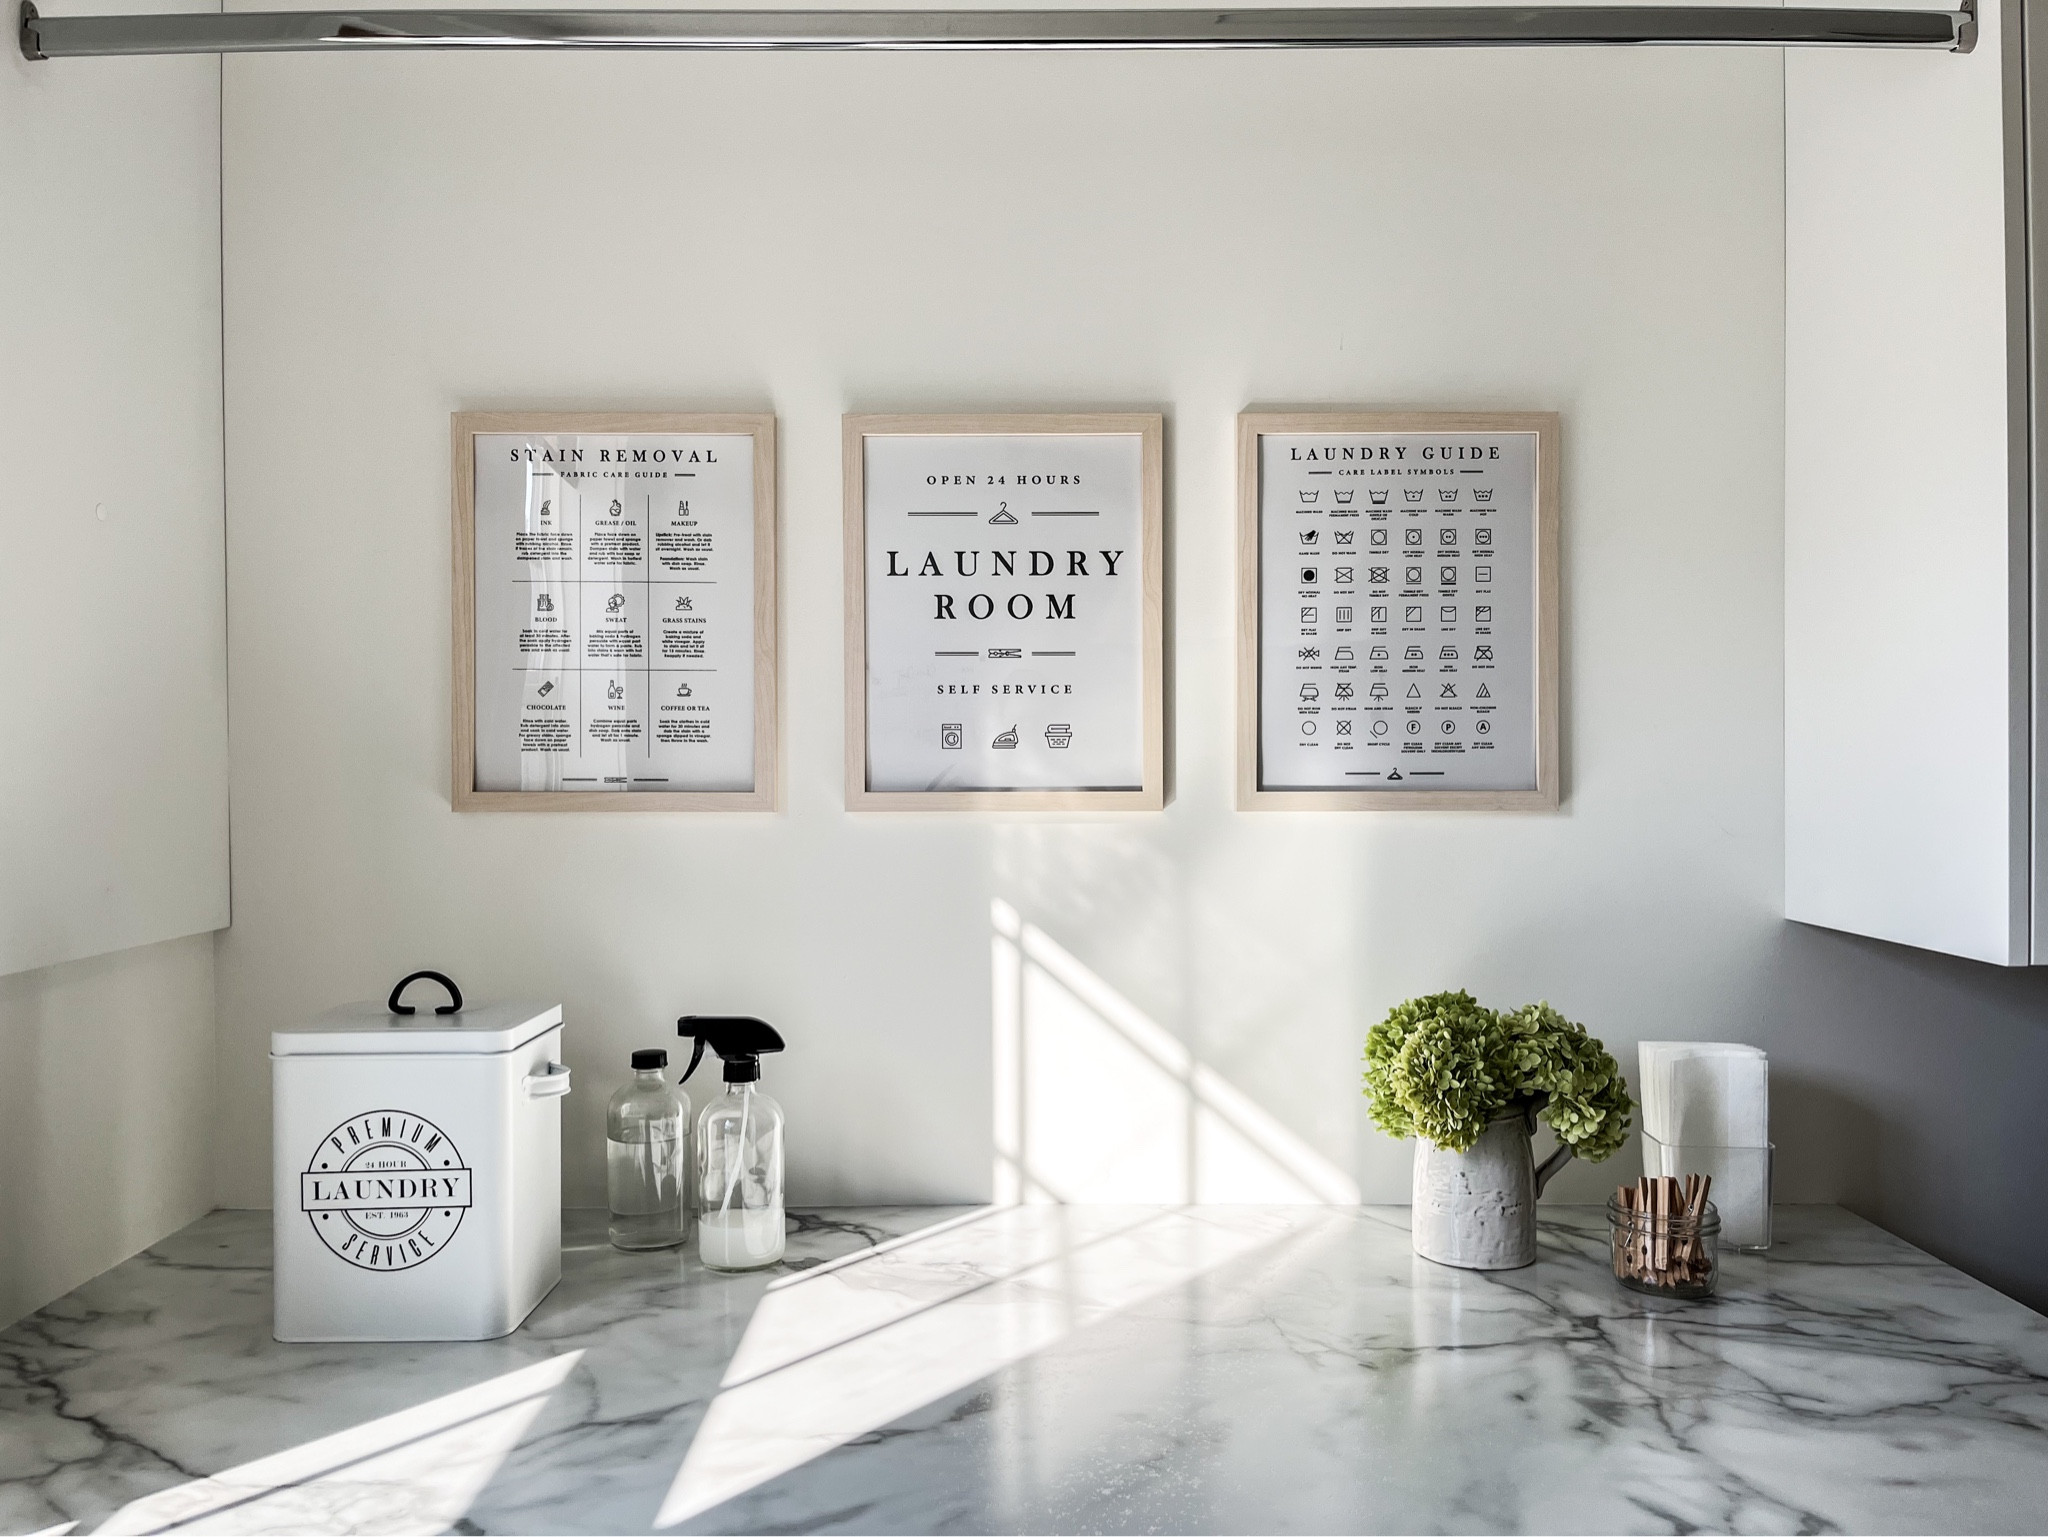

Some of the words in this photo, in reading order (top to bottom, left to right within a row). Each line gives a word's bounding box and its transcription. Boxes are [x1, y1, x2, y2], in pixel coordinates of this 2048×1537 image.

[510, 450, 584, 462] STAIN
[600, 450, 717, 462] REMOVAL
[1291, 447, 1407, 460] LAUNDRY
[1422, 447, 1499, 460] GUIDE
[927, 476, 975, 485] OPEN
[988, 476, 1005, 484] 24
[1017, 475, 1080, 485] HOURS
[887, 551, 1124, 576] LAUNDRY
[934, 594, 1076, 620] ROOM
[937, 685, 980, 694] SELF
[992, 685, 1072, 694] SERVICE
[1480, 723, 1487, 731] A
[331, 1117, 442, 1154] PREMIUM
[312, 1177, 459, 1200] LAUNDRY
[342, 1230, 434, 1266] SERVICE
